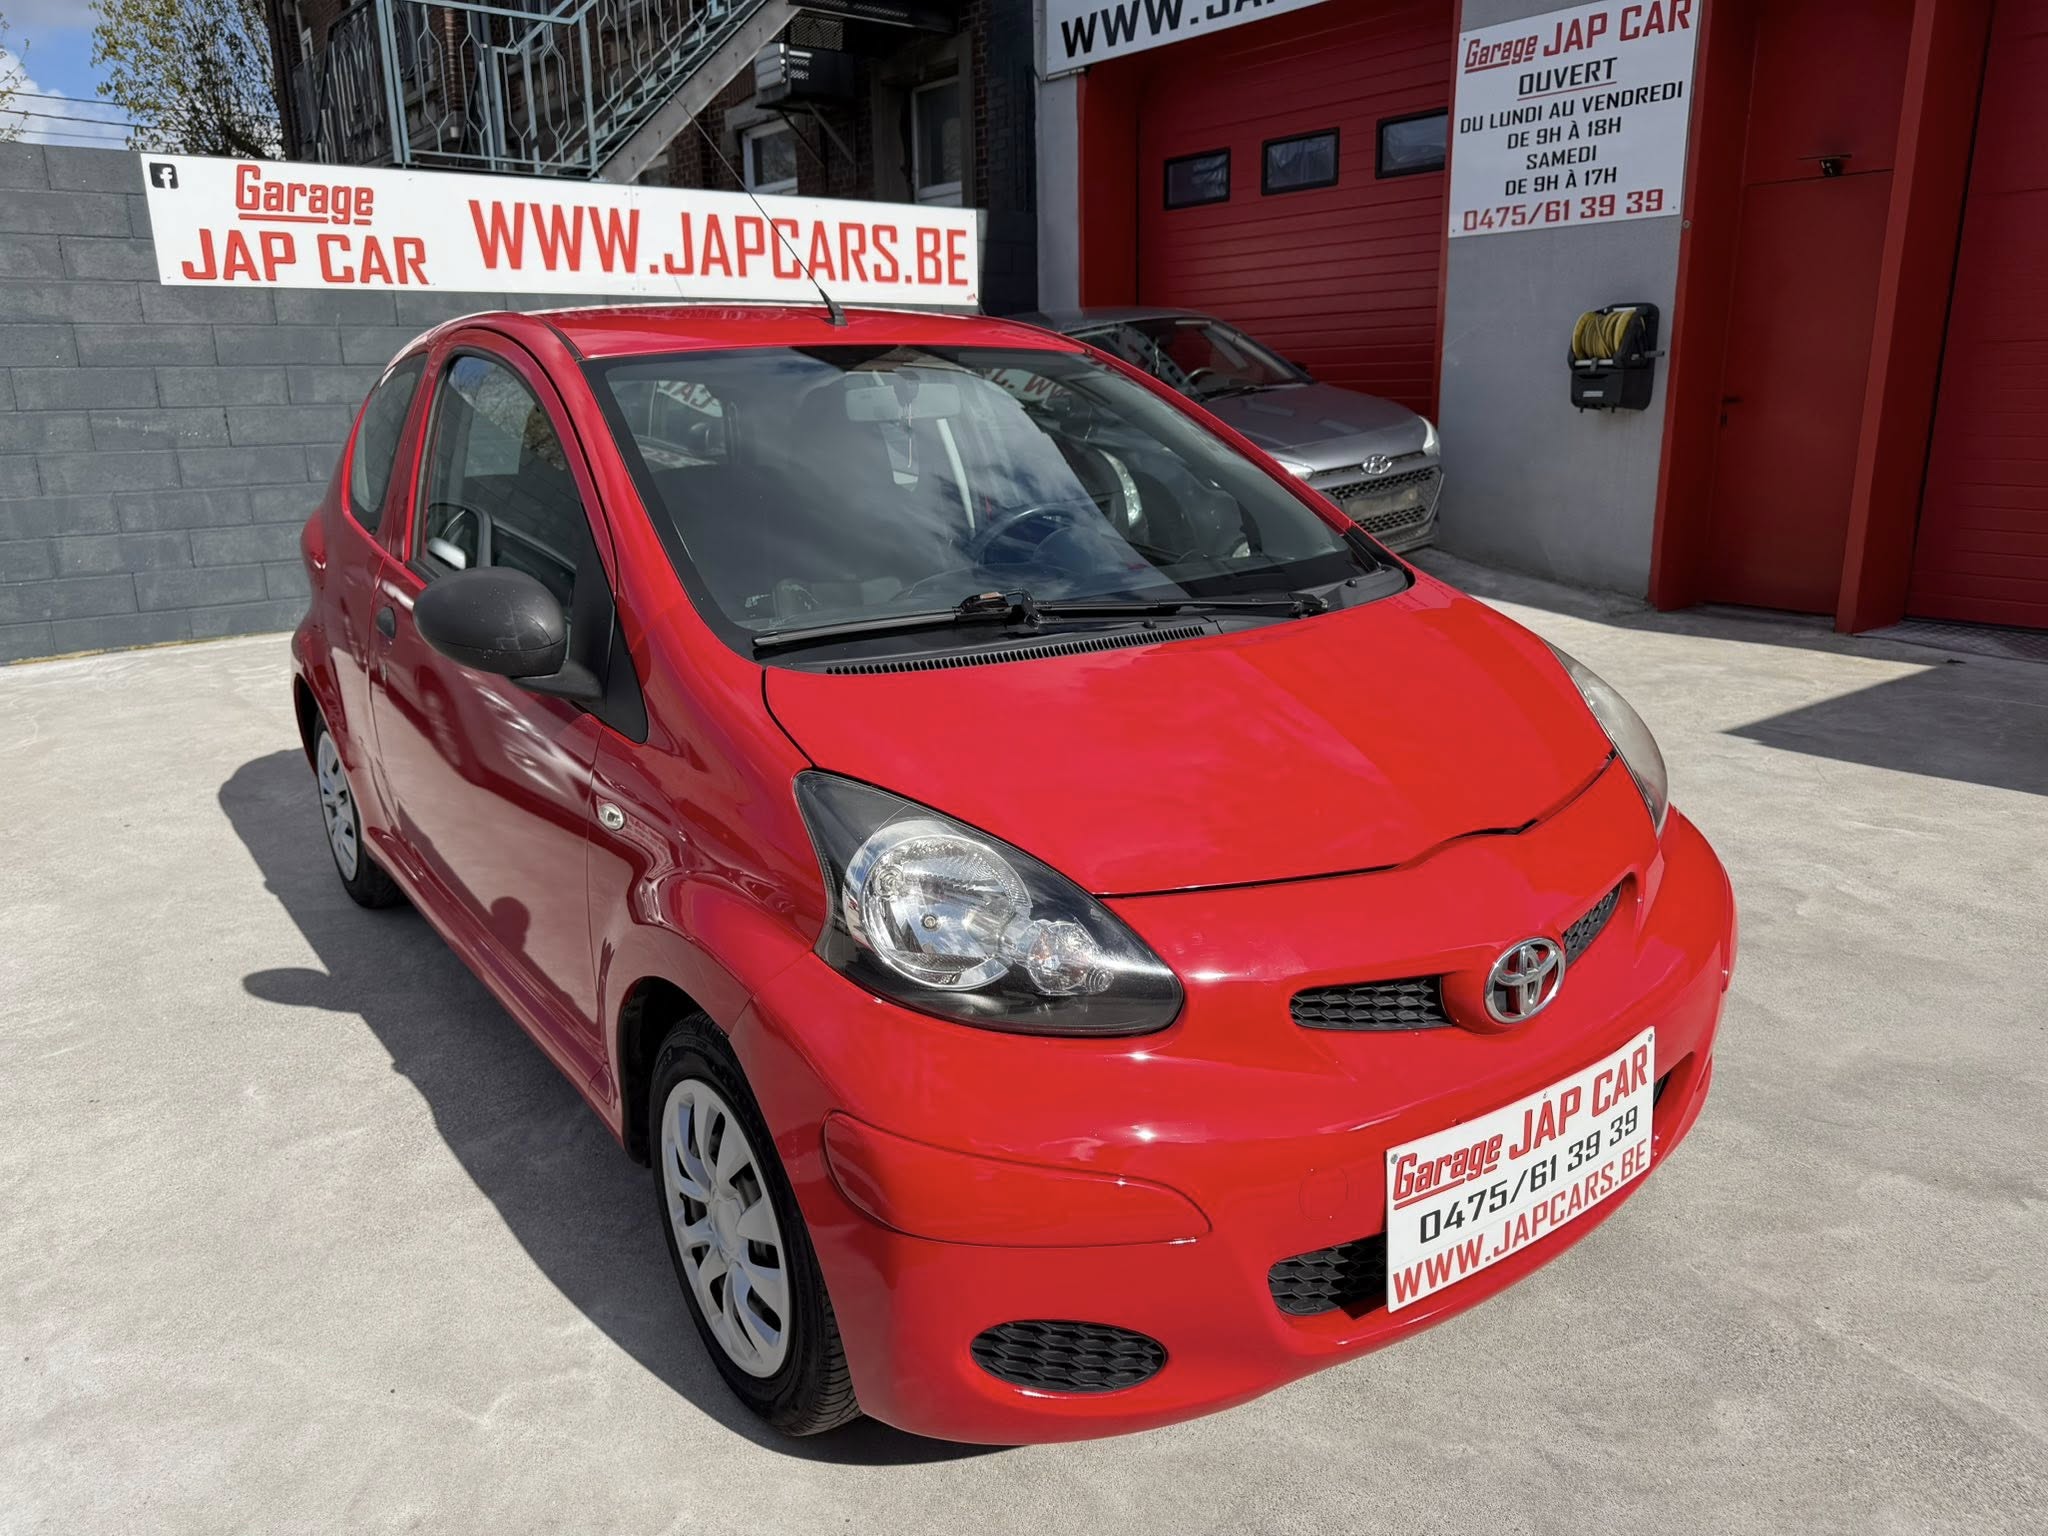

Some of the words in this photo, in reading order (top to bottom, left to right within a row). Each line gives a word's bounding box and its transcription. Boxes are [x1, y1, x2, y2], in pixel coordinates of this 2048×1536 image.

[1465, 35, 1538, 73] Garage
[1543, 12, 1608, 57] JAP
[1619, 0, 1692, 41] CAR
[1518, 57, 1618, 95] OUVERT
[1460, 116, 1483, 133] DU
[1489, 105, 1542, 129] LUNDI
[1549, 100, 1575, 119] AU
[1582, 81, 1683, 113] VENDREDI
[1507, 131, 1529, 149] DE
[1536, 127, 1561, 145] 9H
[1568, 121, 1580, 140] À
[1587, 117, 1621, 137] 18H
[1505, 179, 1527, 196] DE
[1533, 175, 1558, 193] 9H
[1565, 169, 1577, 188] À
[1584, 167, 1617, 188] 17H
[1526, 145, 1597, 170] SAMEDI
[236, 164, 374, 225] Garage
[1463, 199, 1570, 231] 0475/61
[1580, 194, 1616, 219] 39
[1626, 189, 1664, 214] 39
[181, 228, 296, 281] JAP
[317, 233, 430, 285] CAR
[468, 200, 968, 285] WWW.JAPCARS.BE
[1393, 1134, 1503, 1204] Garage
[1508, 1086, 1581, 1161] JAP
[1592, 1044, 1647, 1117] CAR
[1420, 1155, 1557, 1244] 0475/61
[1567, 1130, 1601, 1172] 39
[1609, 1105, 1638, 1147] 39
[1393, 1138, 1647, 1303] WWW.JAPCARS.BE
